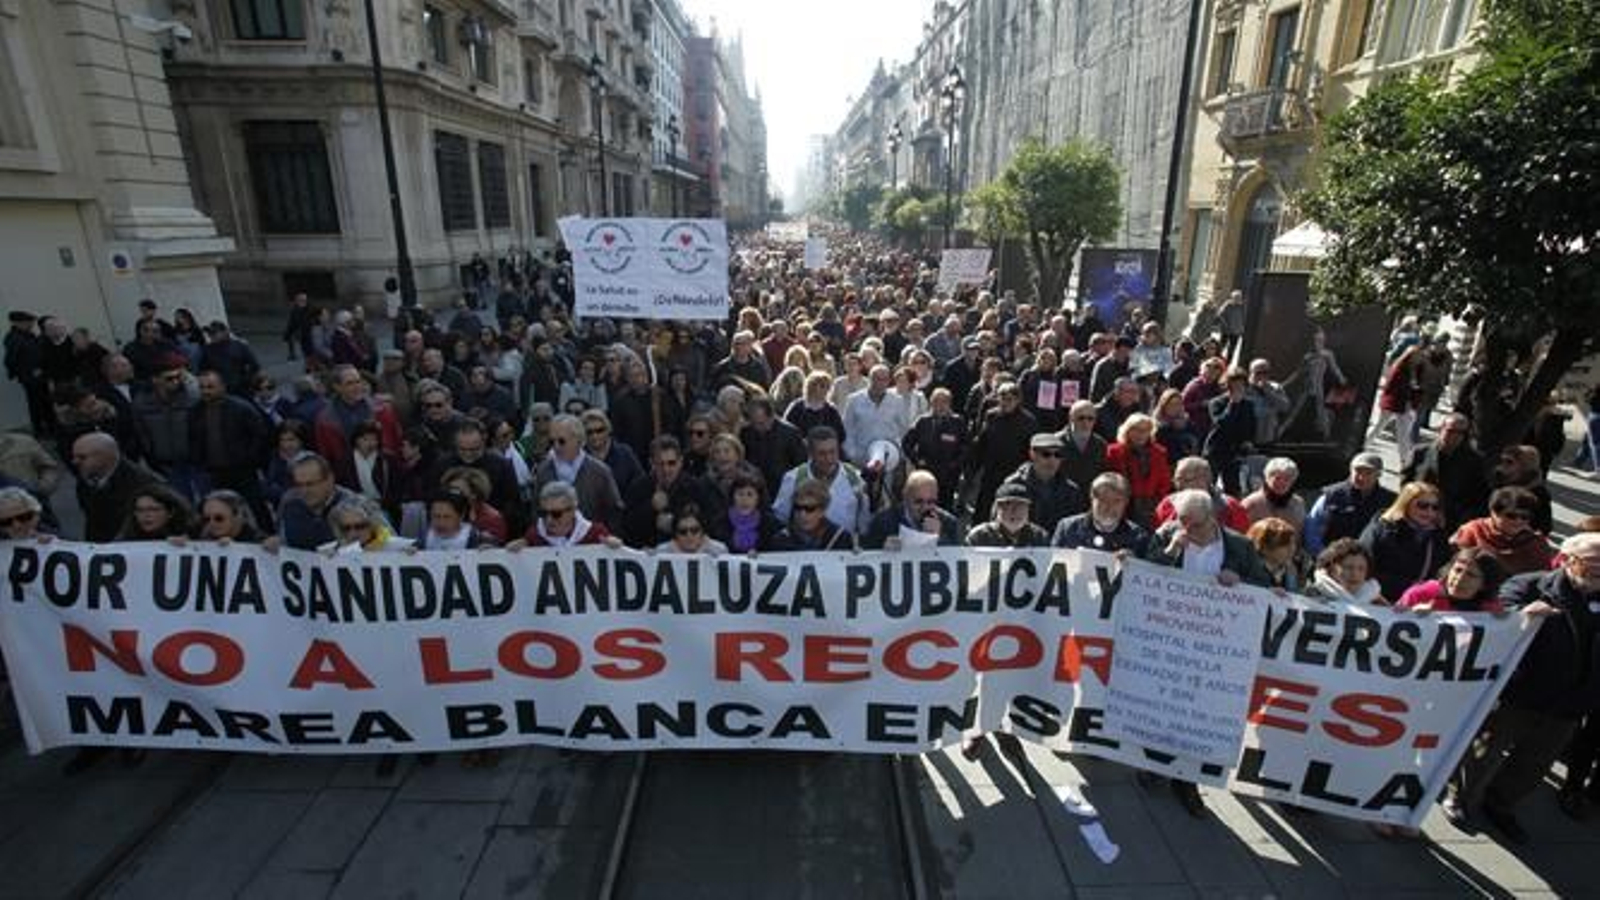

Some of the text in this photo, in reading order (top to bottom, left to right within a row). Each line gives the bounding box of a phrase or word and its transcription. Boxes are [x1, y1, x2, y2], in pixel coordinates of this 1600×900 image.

[8, 546, 128, 610] POR
[152, 553, 267, 615] UNA
[281, 561, 516, 624] SANIDAD
[535, 559, 827, 618] ANDALUZA
[845, 558, 1071, 619] PUBLICA
[1095, 565, 1124, 619] Y
[62, 623, 1440, 750] NO A LOS RECORES.
[66, 694, 1425, 812] MAREA BLANCA EN SELLA
